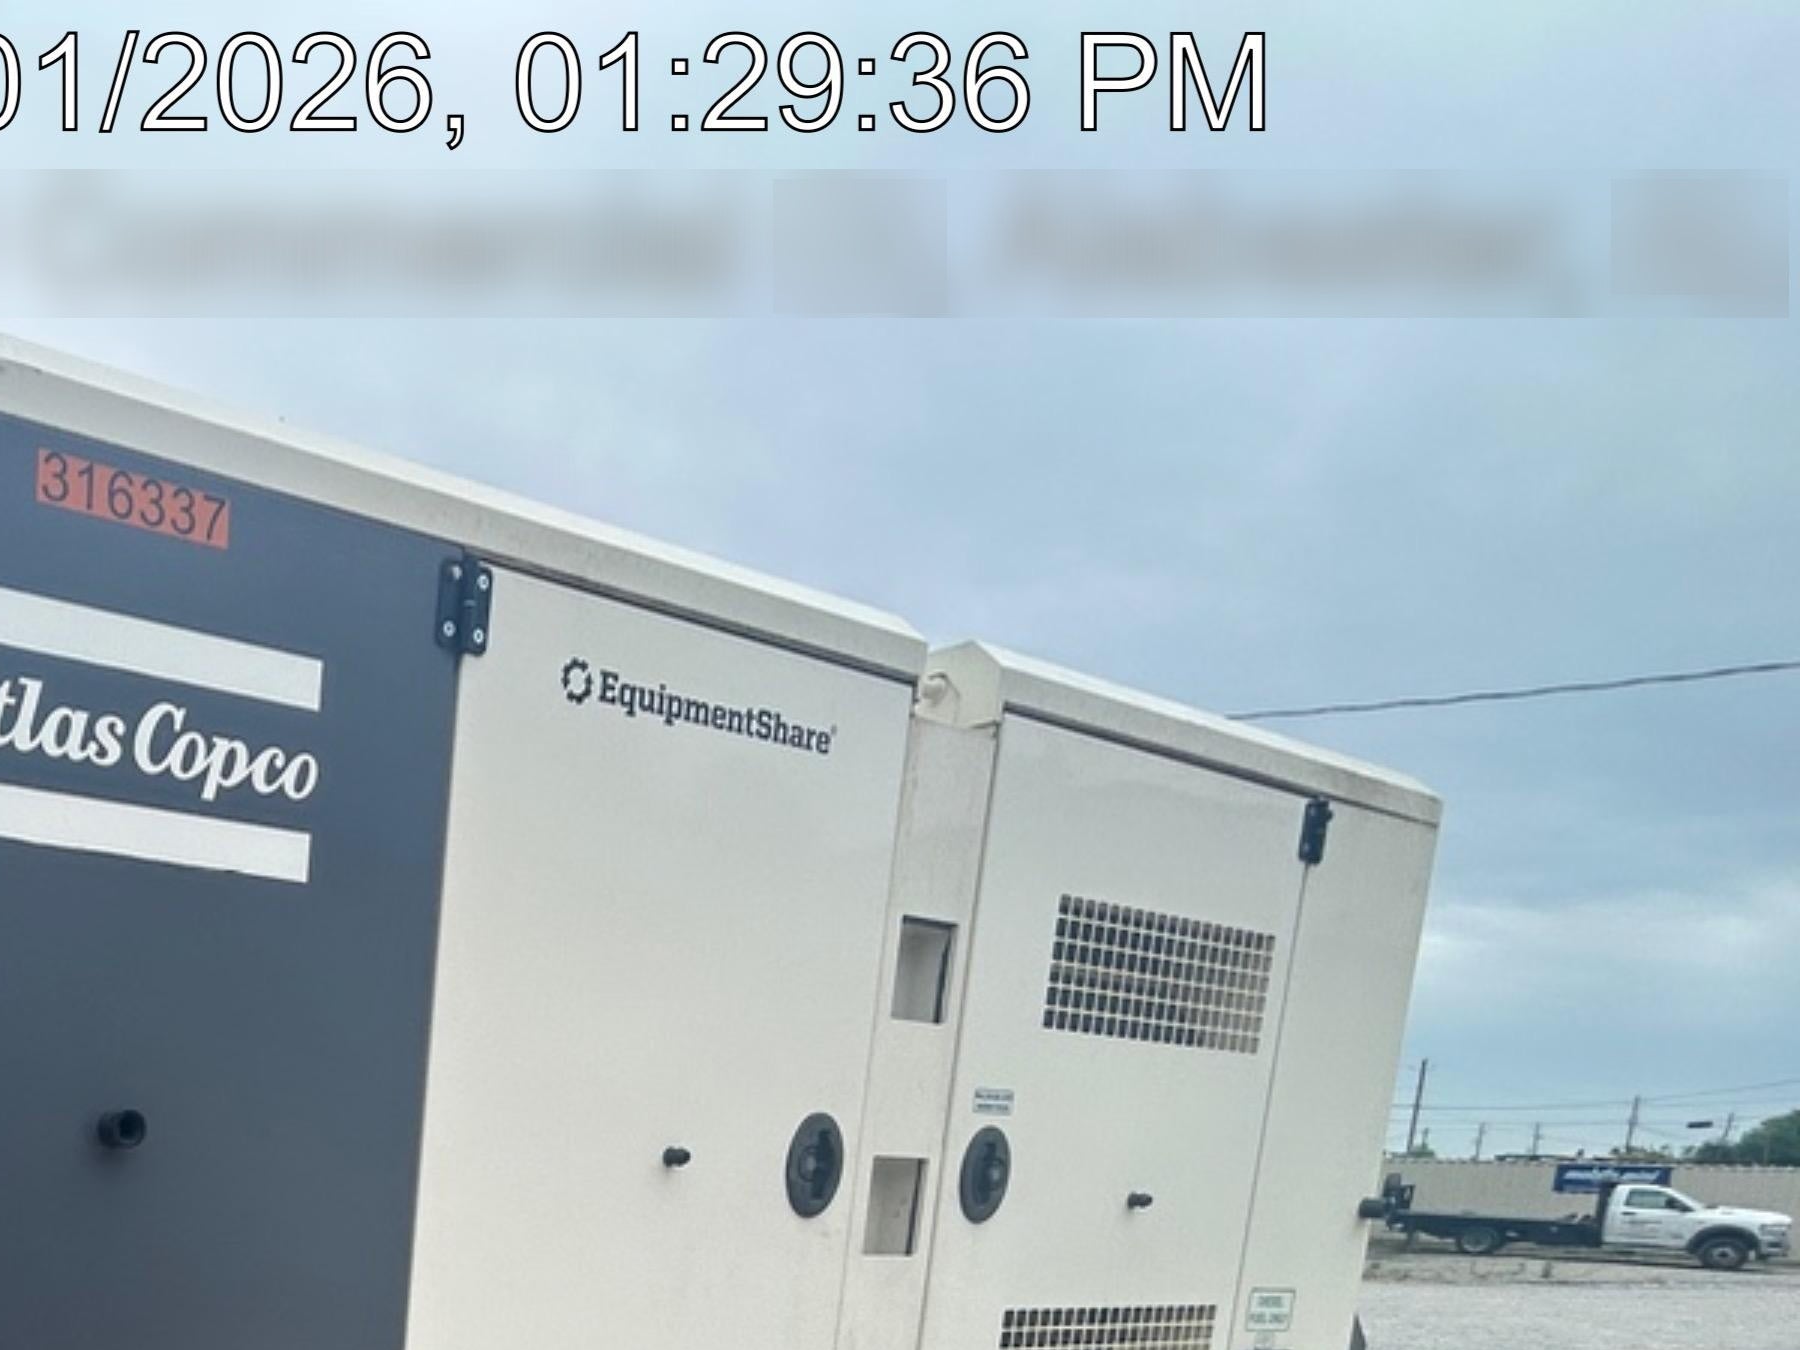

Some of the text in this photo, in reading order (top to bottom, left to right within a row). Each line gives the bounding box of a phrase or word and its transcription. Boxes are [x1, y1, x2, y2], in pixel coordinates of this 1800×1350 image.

[40, 450, 228, 542] 316337
[133, 700, 319, 801] Copco
[599, 670, 833, 754] EquipmentShare
